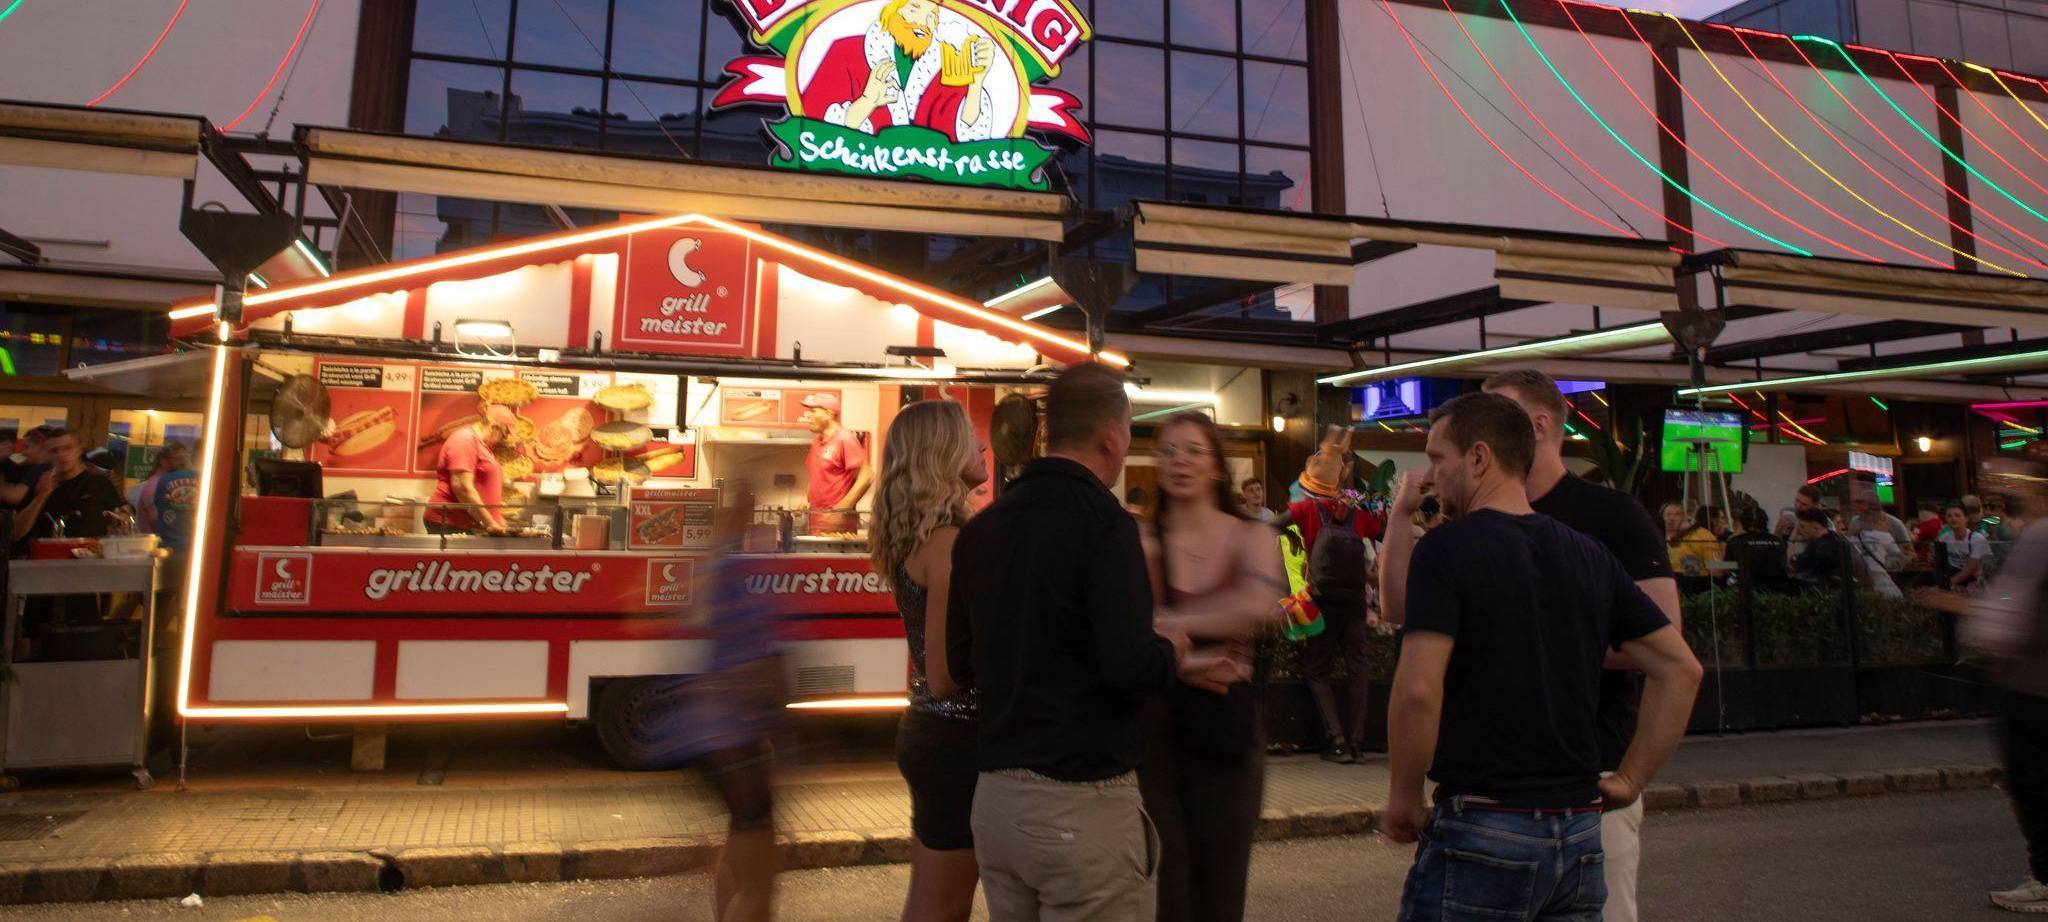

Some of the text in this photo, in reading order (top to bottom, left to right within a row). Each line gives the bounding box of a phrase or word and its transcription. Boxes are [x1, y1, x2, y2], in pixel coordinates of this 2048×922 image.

[799, 131, 1025, 176] Schinkenstrasse
[660, 293, 711, 316] grill
[640, 315, 727, 336] meister
[634, 504, 652, 516] XXL
[686, 529, 712, 541] 5,99
[271, 578, 295, 591] grill
[365, 560, 592, 600] grillmeister
[660, 583, 680, 594] grill
[651, 591, 688, 601] meister
